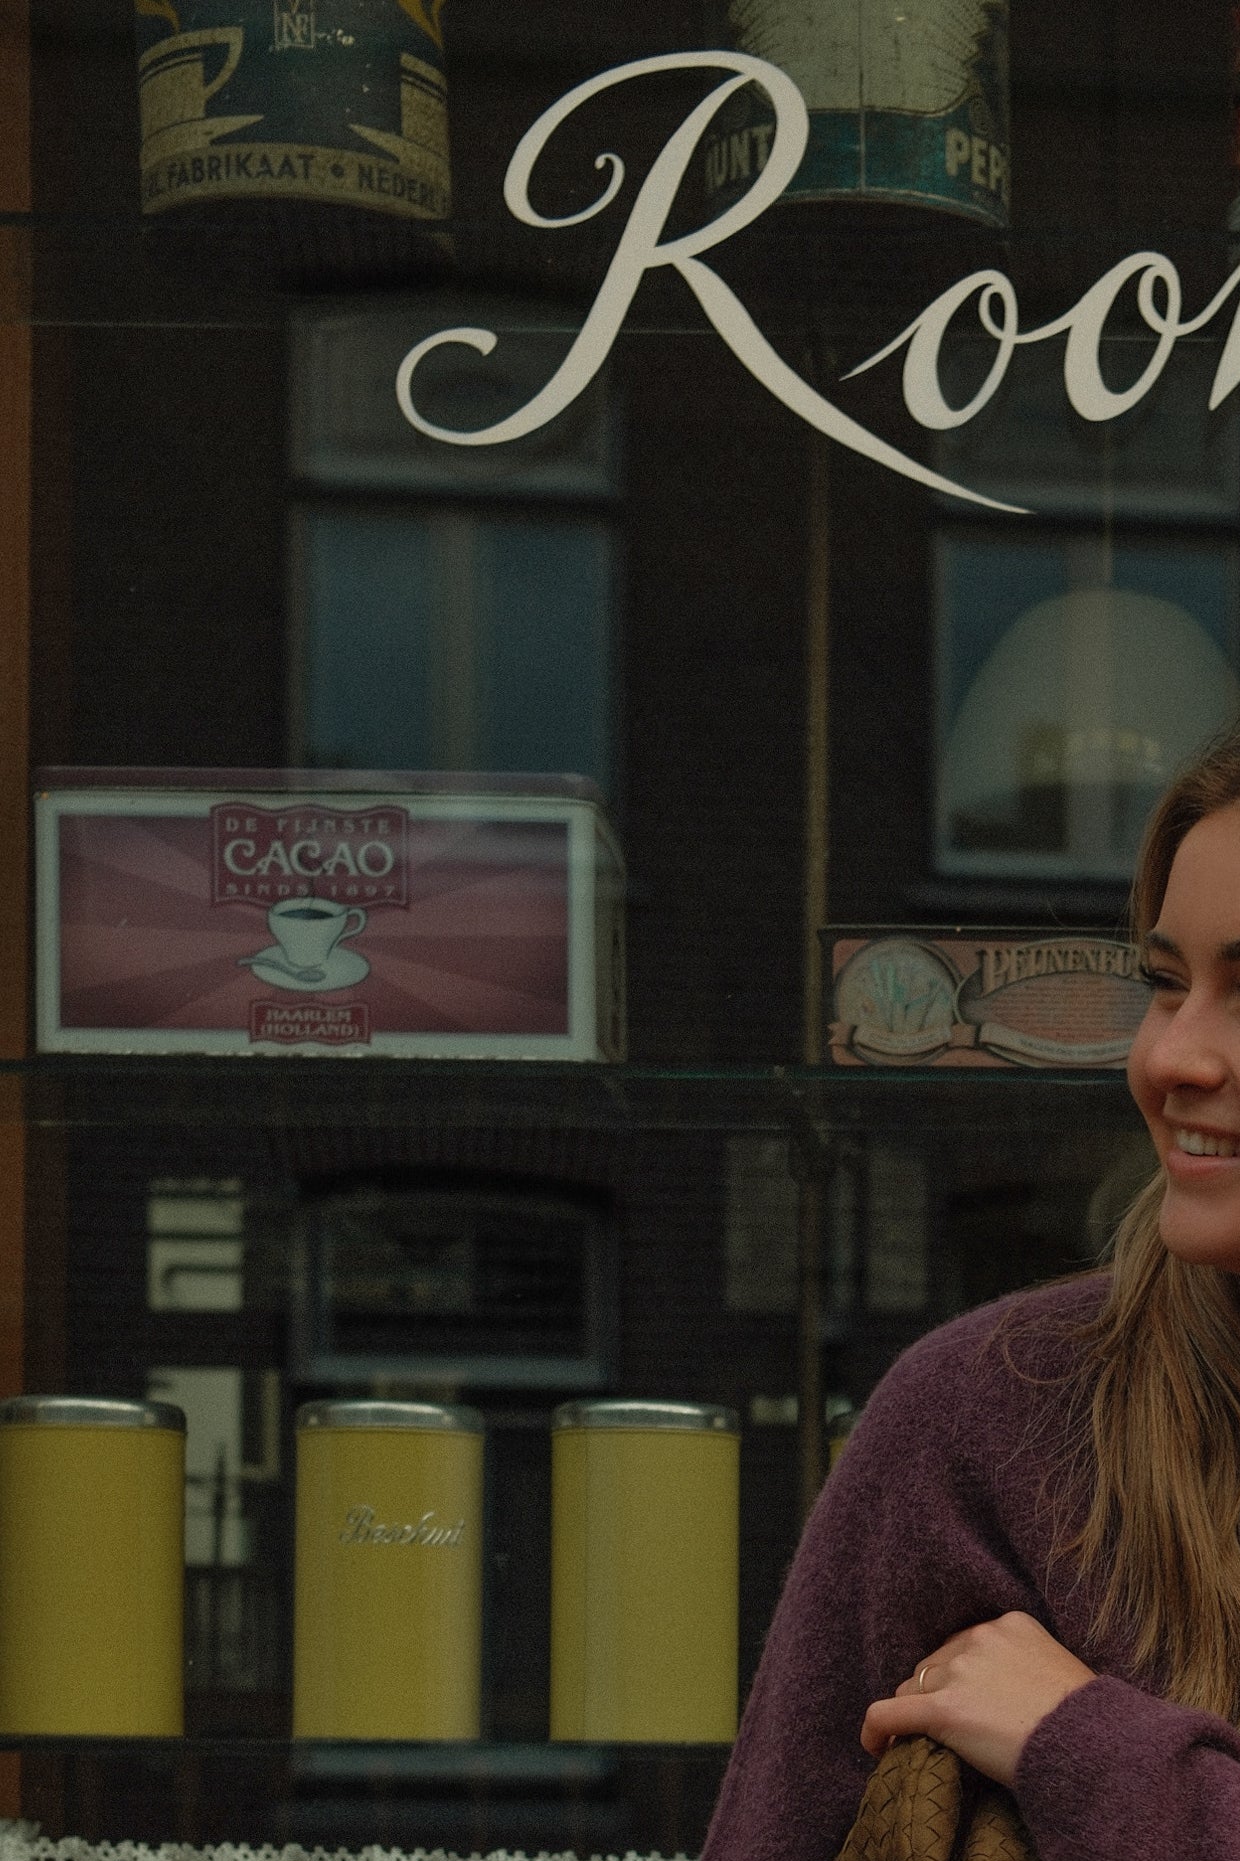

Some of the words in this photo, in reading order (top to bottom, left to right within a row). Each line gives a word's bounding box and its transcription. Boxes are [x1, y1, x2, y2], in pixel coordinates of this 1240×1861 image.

[167, 153, 314, 188] FABRIKAAT
[225, 816, 258, 833] DE
[222, 837, 395, 878] CACAO
[225, 882, 310, 896] SINDS
[266, 1008, 352, 1024] HAARLEM
